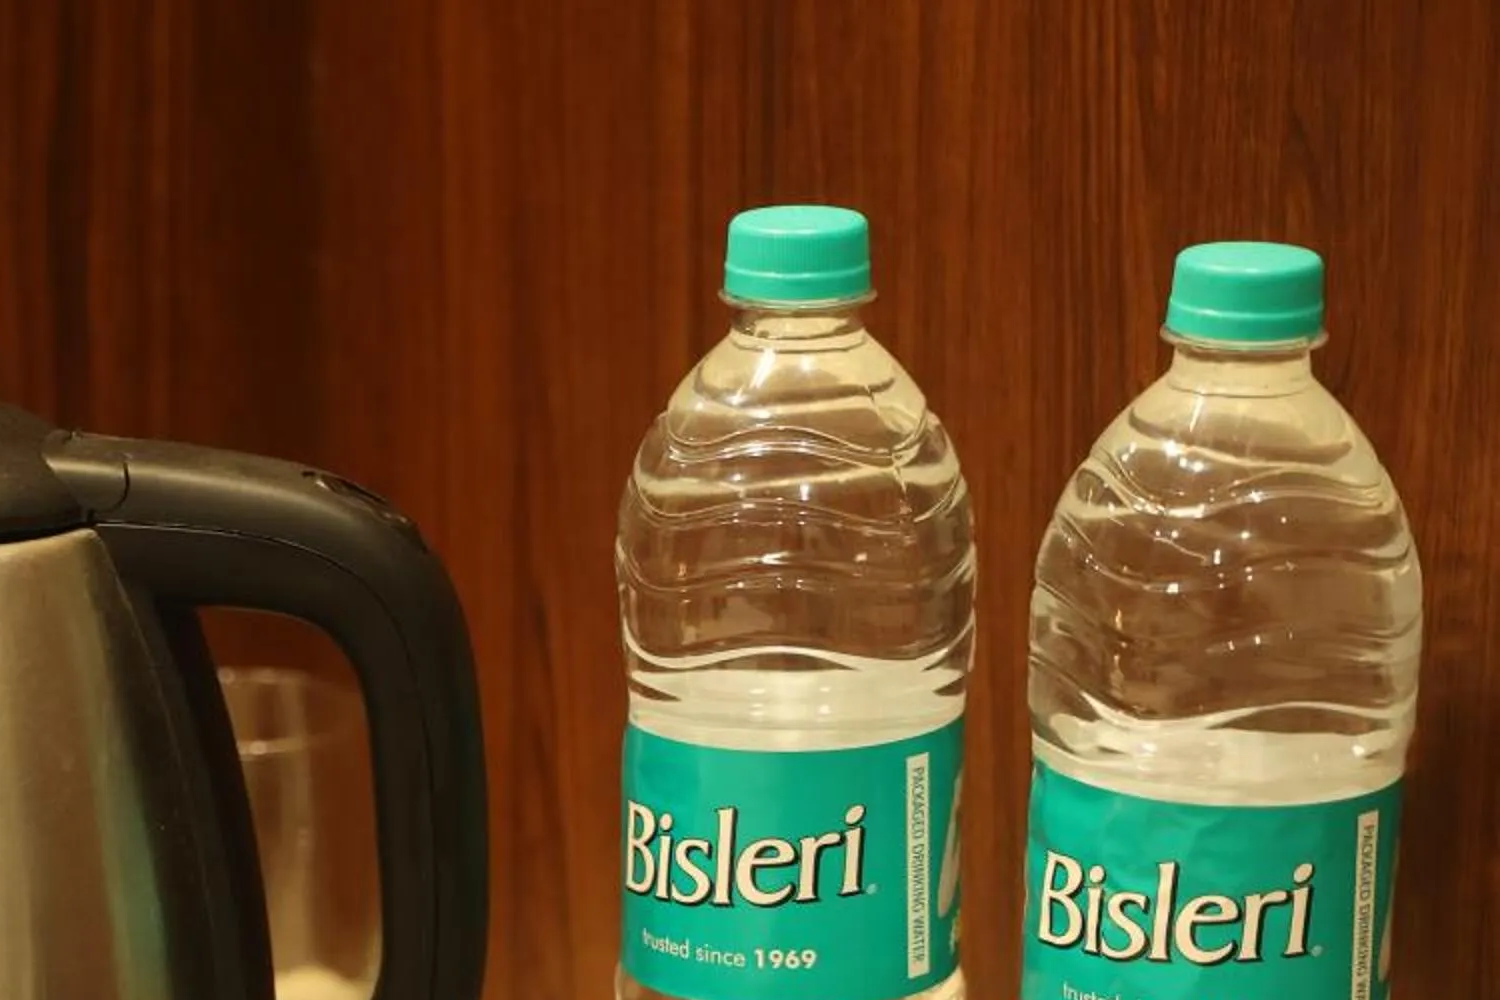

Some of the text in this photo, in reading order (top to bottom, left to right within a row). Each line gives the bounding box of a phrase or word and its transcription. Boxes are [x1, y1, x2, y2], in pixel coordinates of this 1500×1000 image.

[624, 799, 866, 907] Bisleri
[1036, 848, 1315, 966] Bisleri
[641, 927, 818, 970] trusted since 1969
